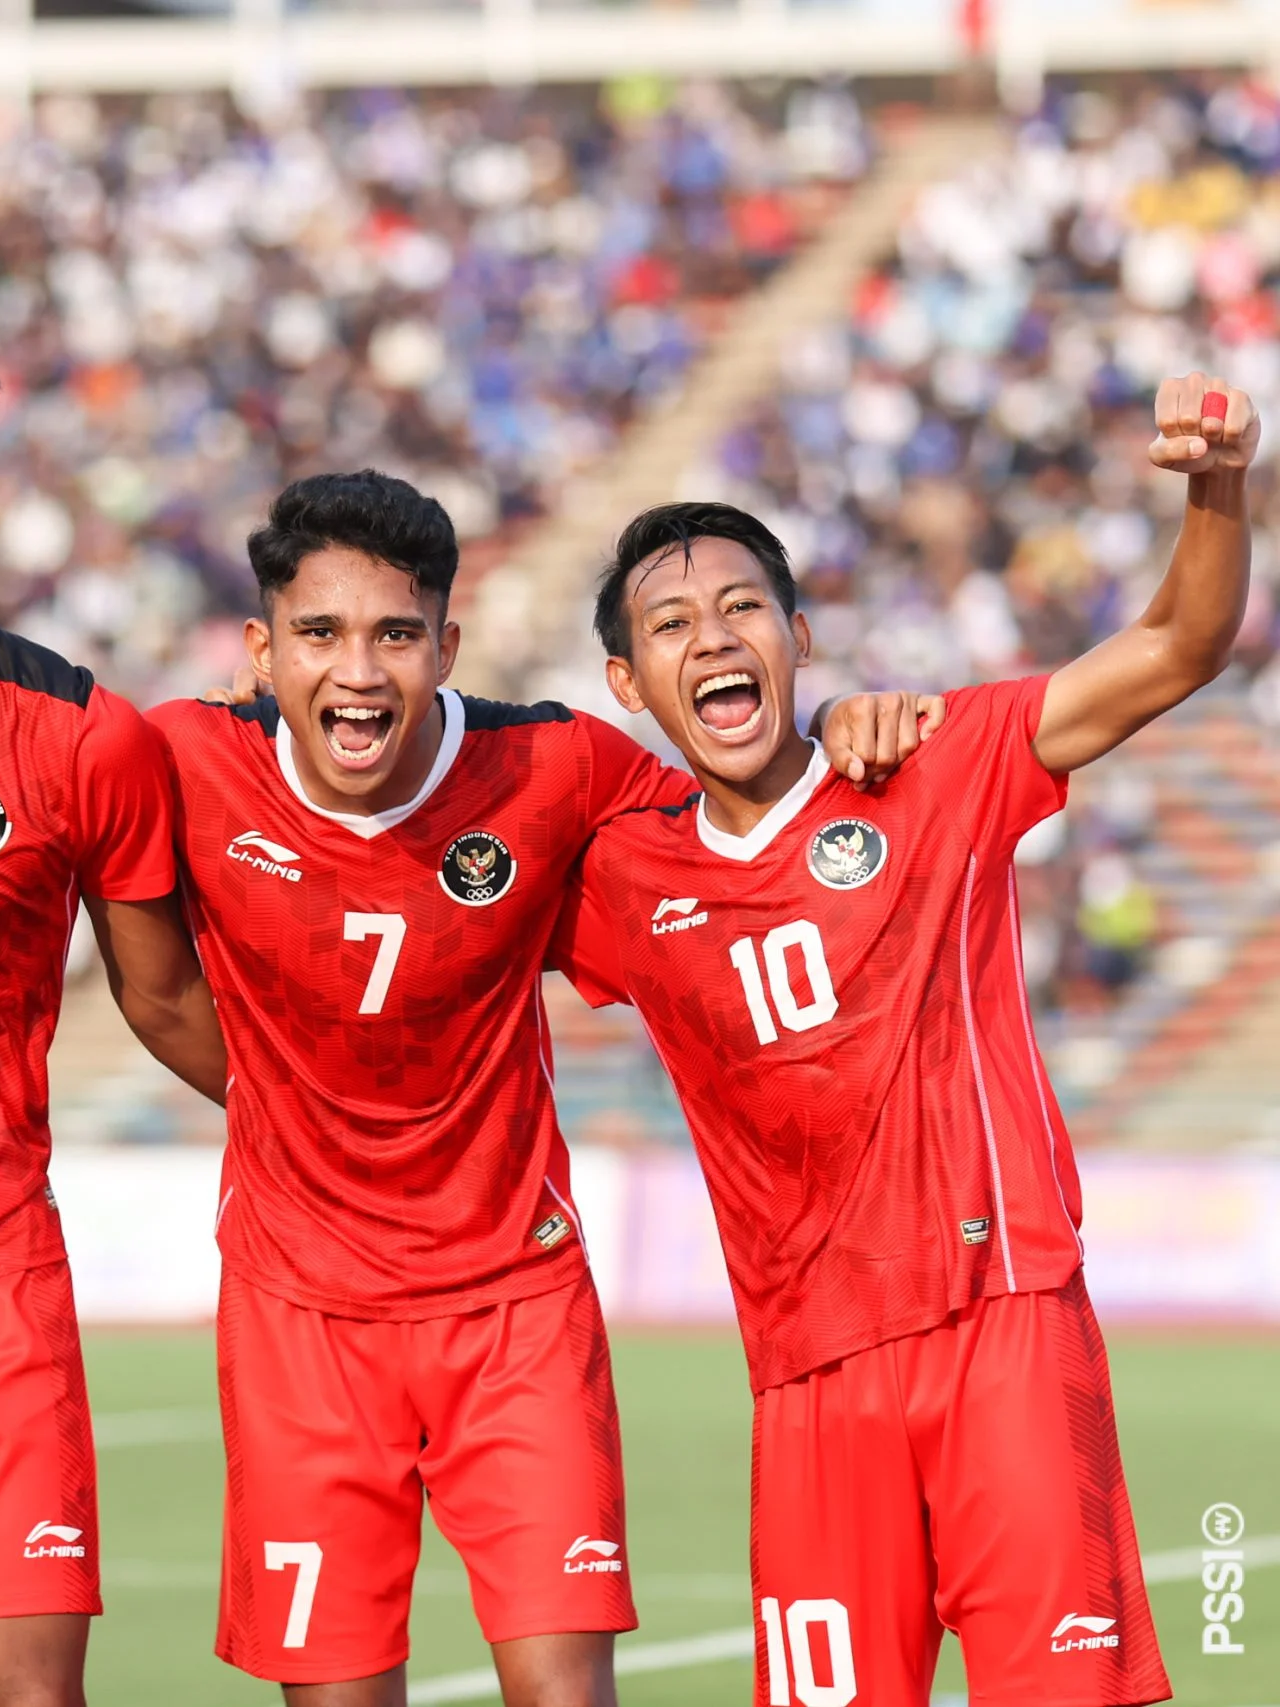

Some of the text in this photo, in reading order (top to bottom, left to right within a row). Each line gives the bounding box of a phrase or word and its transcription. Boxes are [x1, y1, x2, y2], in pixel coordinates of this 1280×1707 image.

[226, 844, 303, 882] LI-NING
[444, 843, 457, 863] TIM
[652, 911, 709, 935] LI-NING
[343, 911, 407, 1015] 7
[729, 918, 840, 1046] 10
[23, 1545, 85, 1559] LI-NING
[563, 1559, 622, 1574] LI-NING
[263, 1540, 324, 1649] 7
[760, 1596, 858, 1707] 10
[1050, 1634, 1120, 1654] LI-NING
